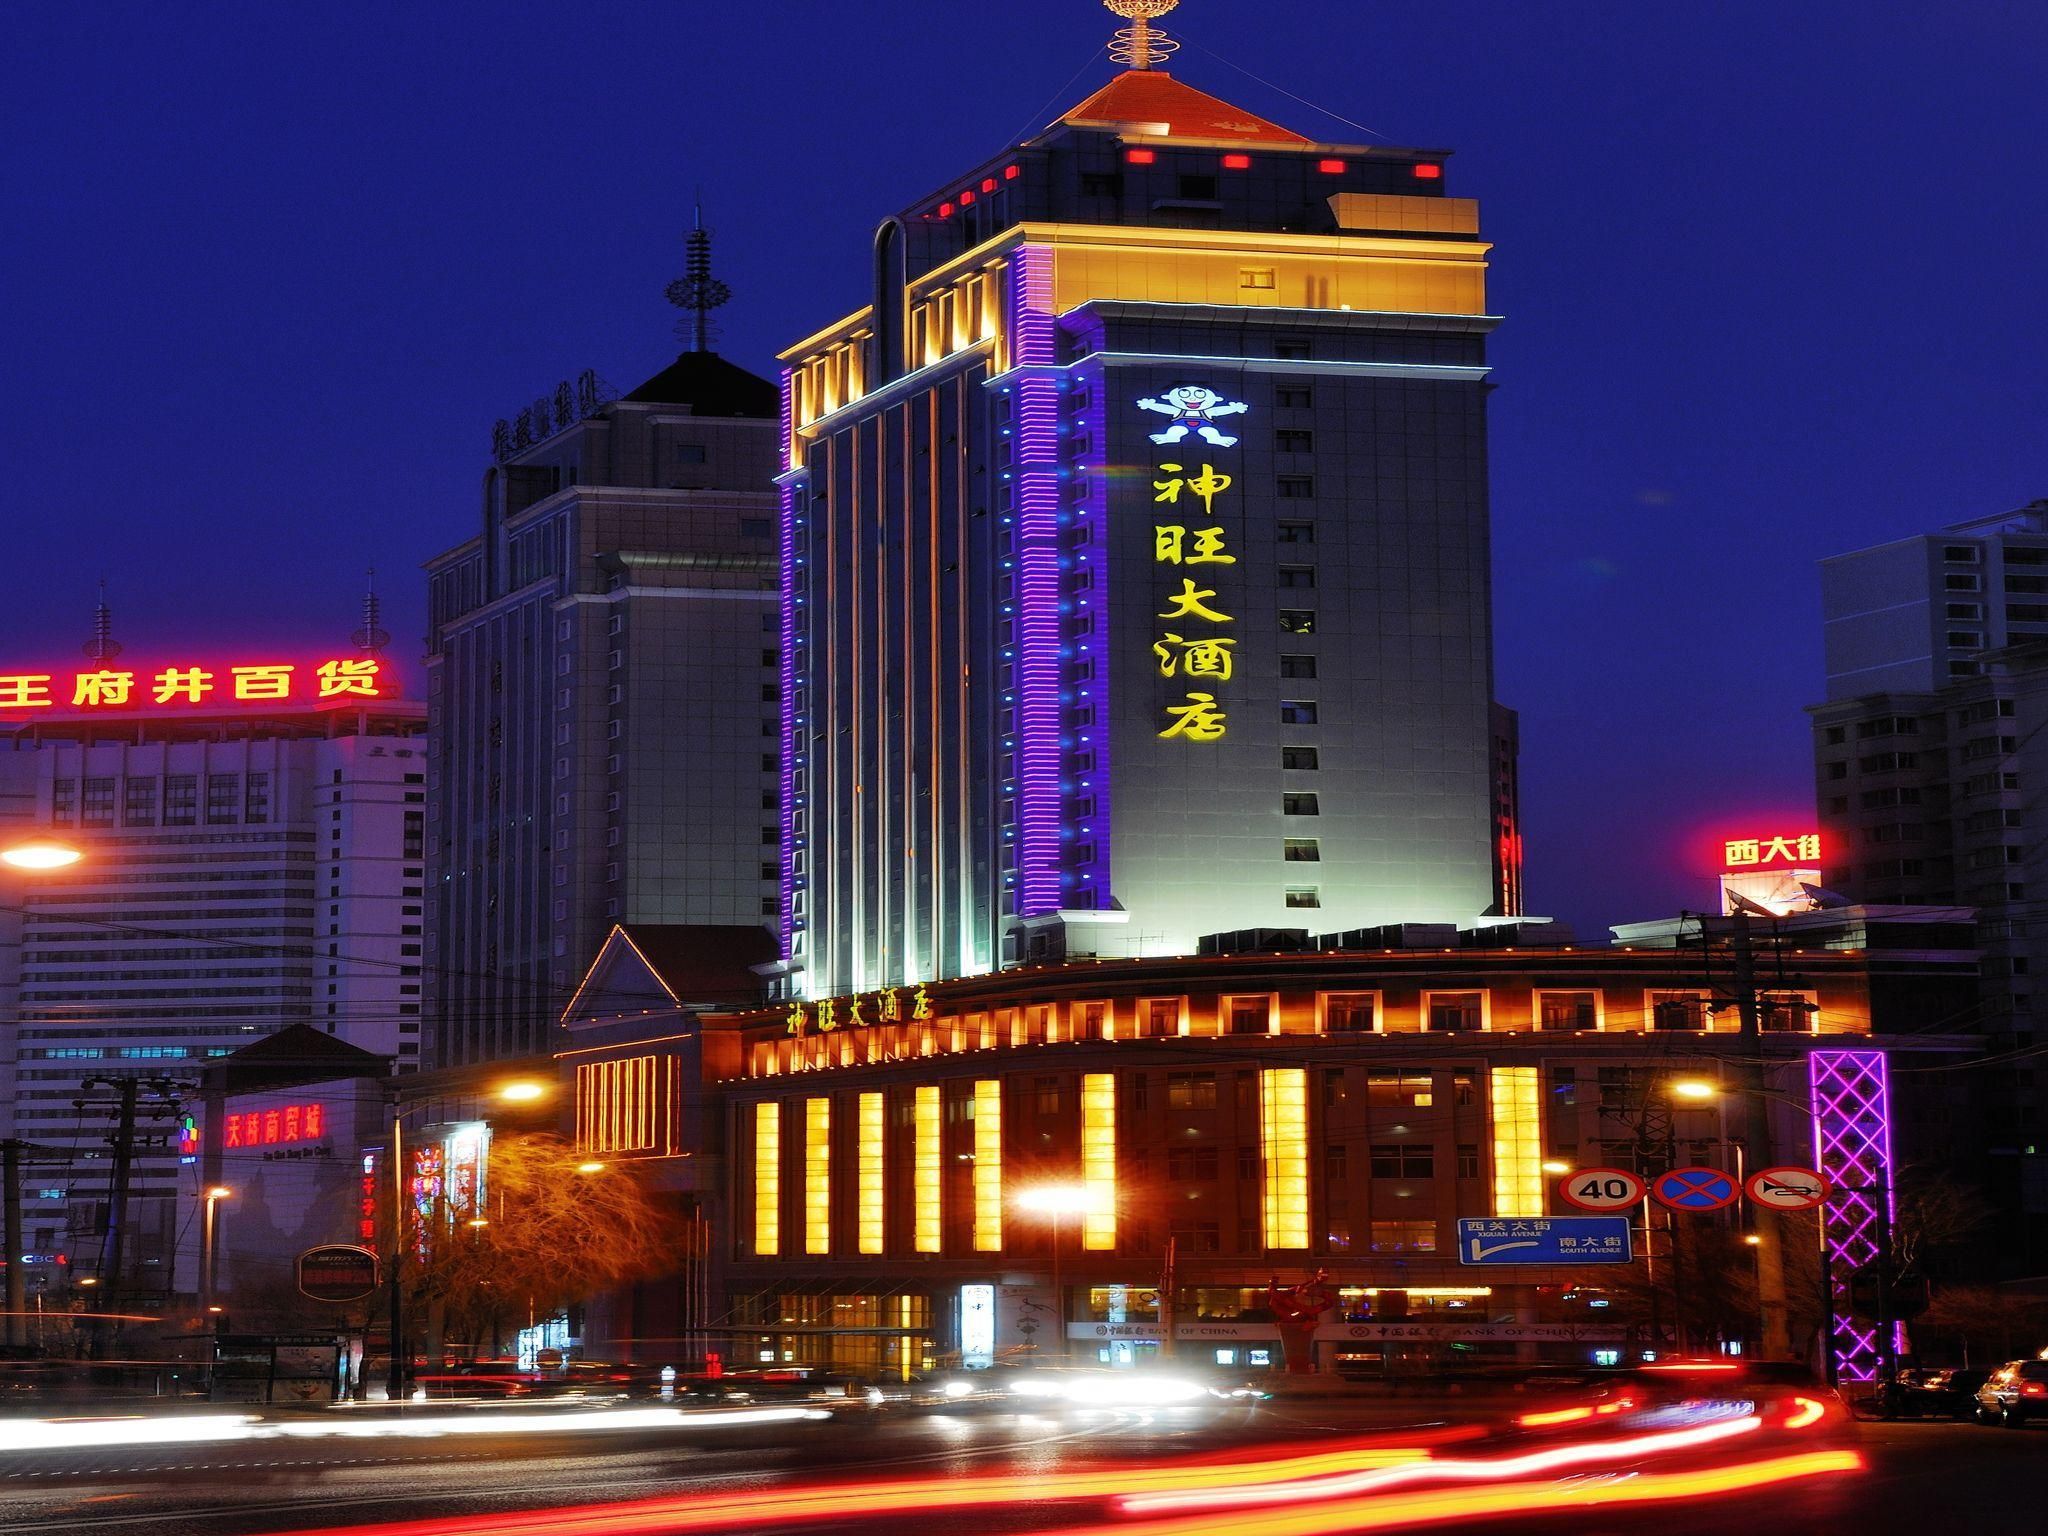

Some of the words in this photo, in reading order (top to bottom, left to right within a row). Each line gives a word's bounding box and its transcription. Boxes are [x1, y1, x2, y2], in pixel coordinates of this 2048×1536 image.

[1152, 462, 1238, 742] 神旺大酒店
[0, 658, 380, 708] 王府井百货
[786, 981, 930, 1034] 神旺大酒店
[1578, 1179, 1628, 1199] 40
[1466, 1220, 1551, 1232] 西关大街
[1559, 1236, 1622, 1247] 南大街
[1200, 1327, 1239, 1335] CHINA
[1504, 1328, 1525, 1336] OF
